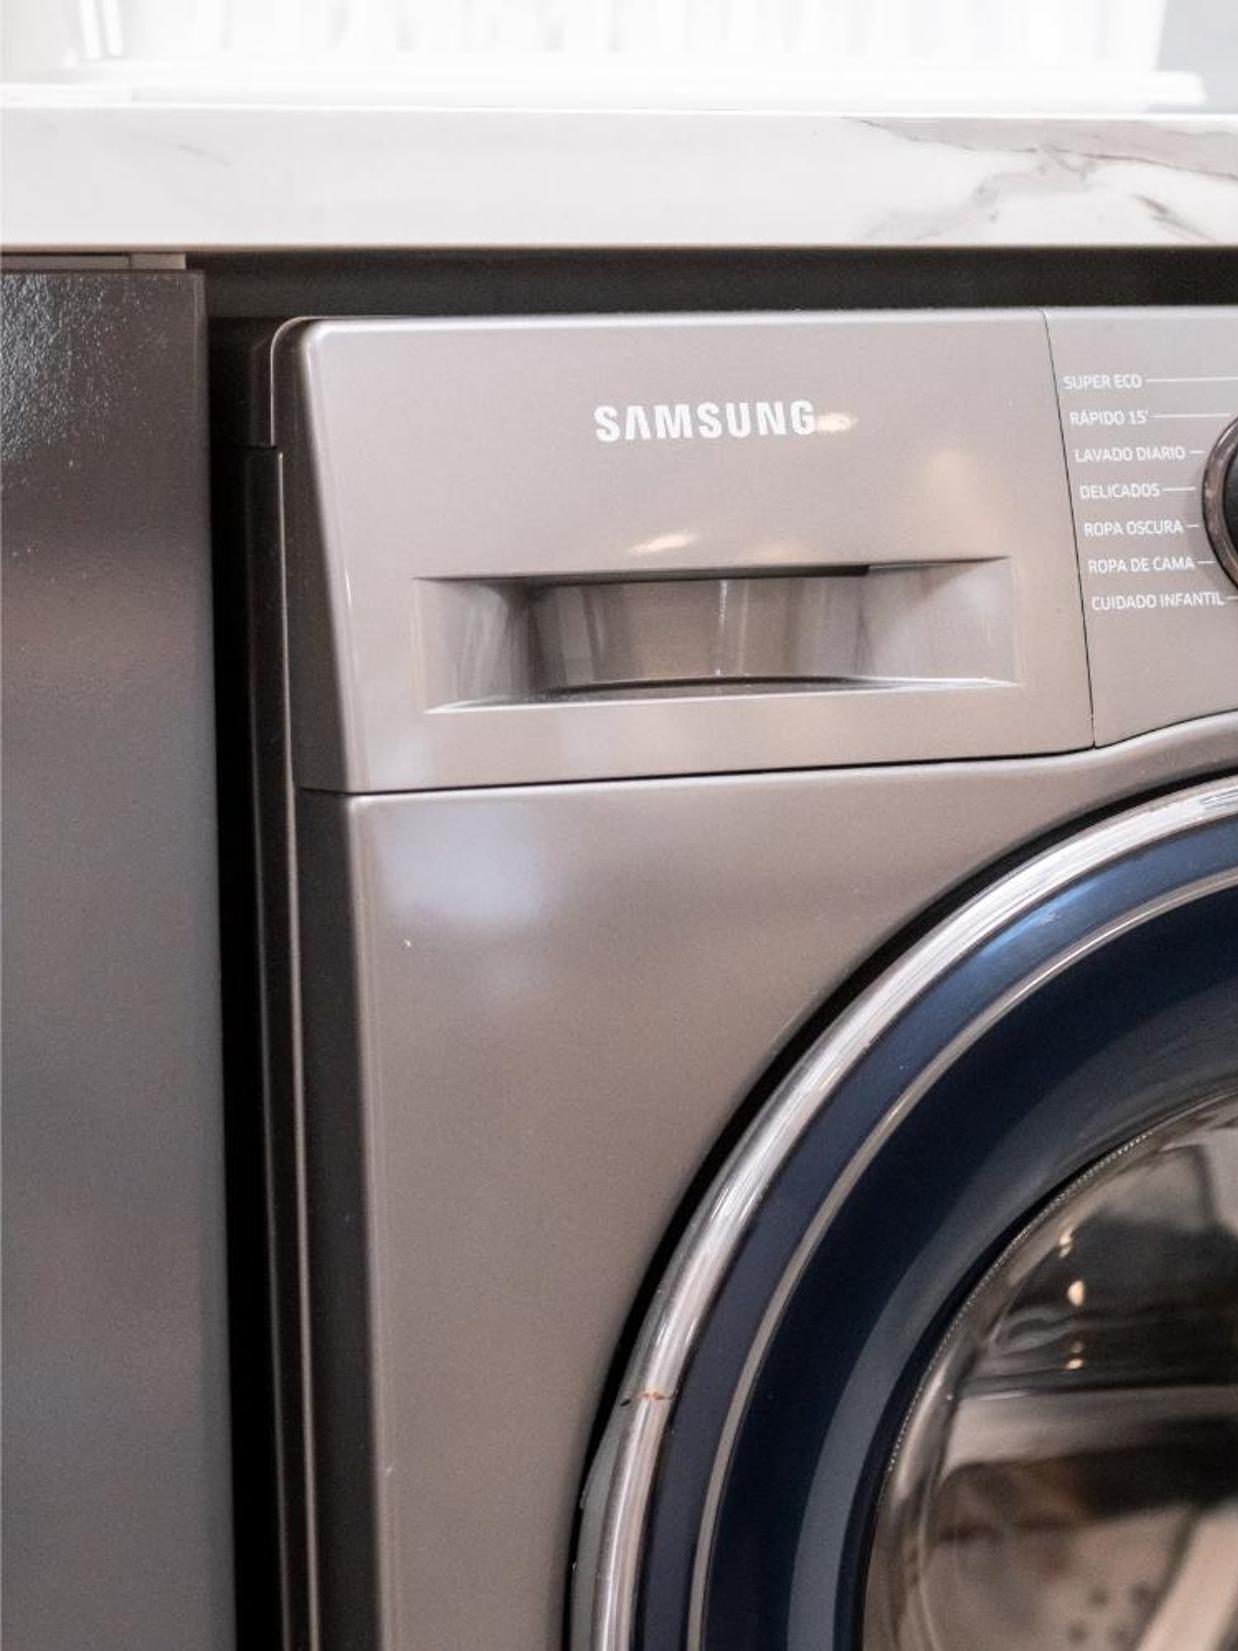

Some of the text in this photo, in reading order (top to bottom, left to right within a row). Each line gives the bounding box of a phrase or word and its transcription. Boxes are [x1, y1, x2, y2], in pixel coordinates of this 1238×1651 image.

[1064, 373, 1143, 390] SUPER ECO
[593, 399, 816, 443] SAMSUNG
[1070, 408, 1125, 425] RÁPIDO
[1075, 446, 1186, 463] LAVADO DIARIO
[1080, 483, 1161, 499] DELICADOS
[1084, 519, 1184, 537] ROPA OSCURA
[1088, 556, 1196, 574] ROPA DE CAMA
[1091, 591, 1225, 611] CUIDADO INFANTIL
